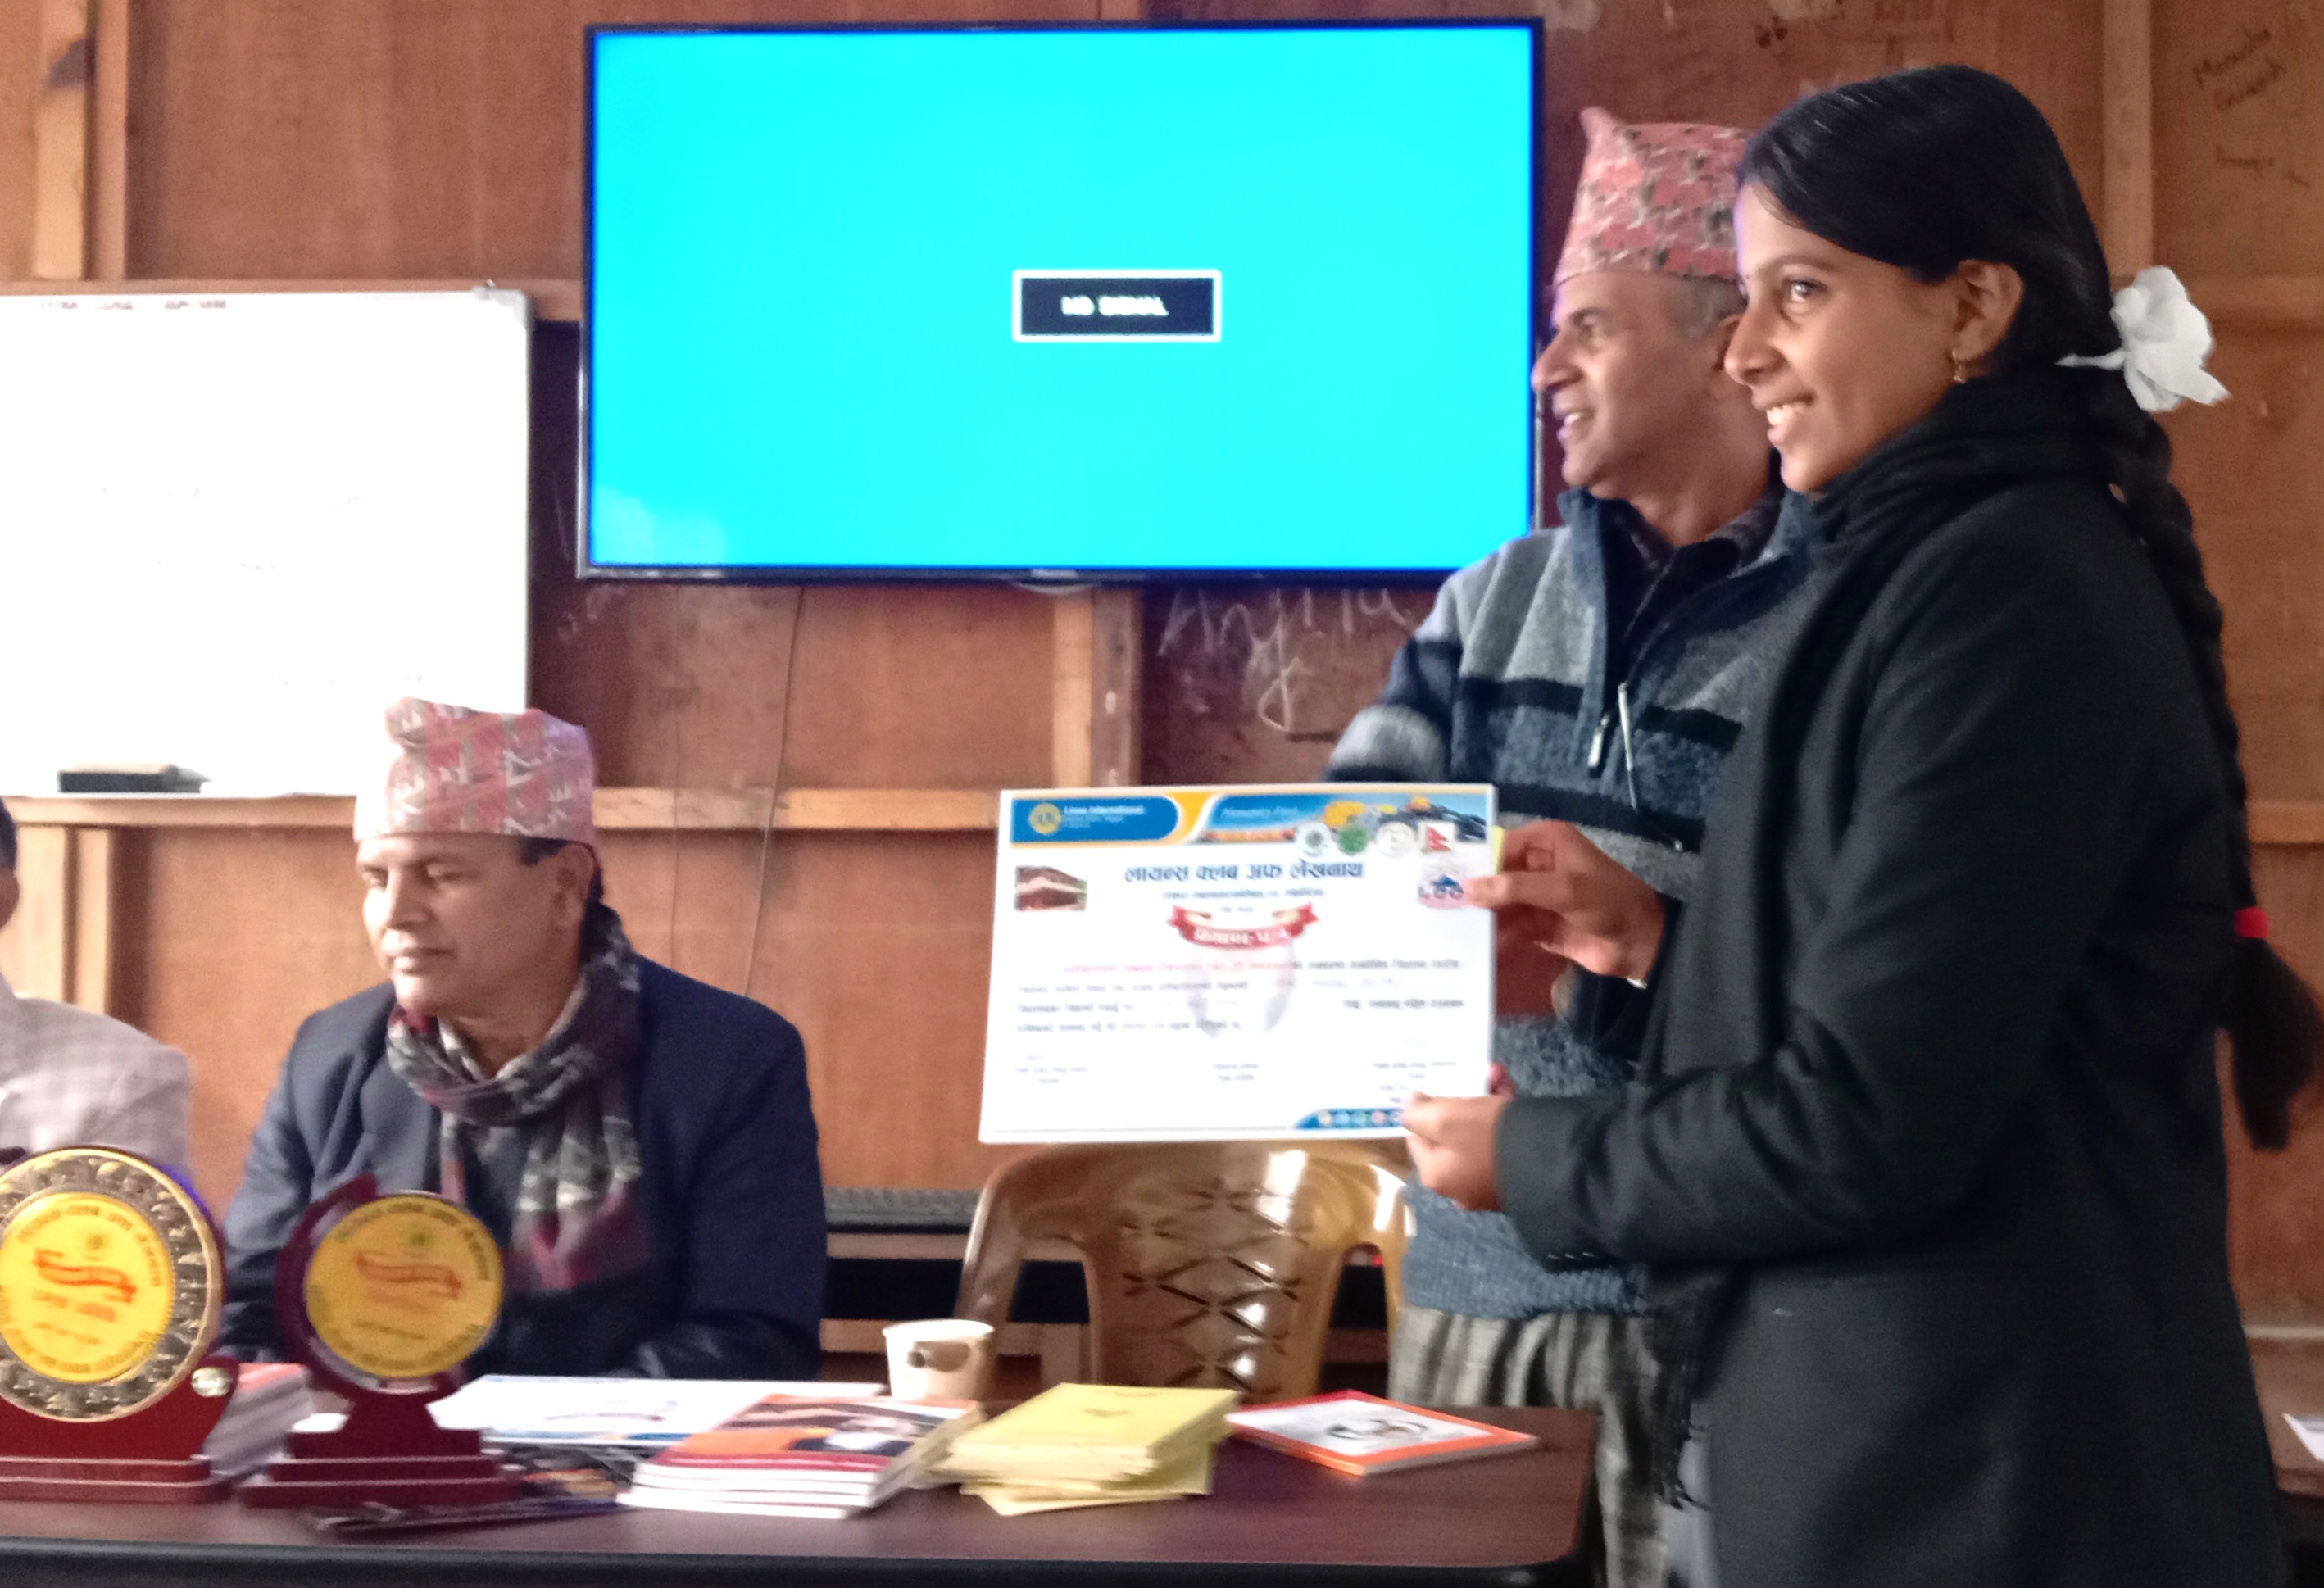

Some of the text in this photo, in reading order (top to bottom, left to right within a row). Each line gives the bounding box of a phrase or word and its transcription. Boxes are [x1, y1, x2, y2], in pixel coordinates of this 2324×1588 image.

[1123, 858, 1365, 883] लायन्स क्लब अफ लेखनाथ
